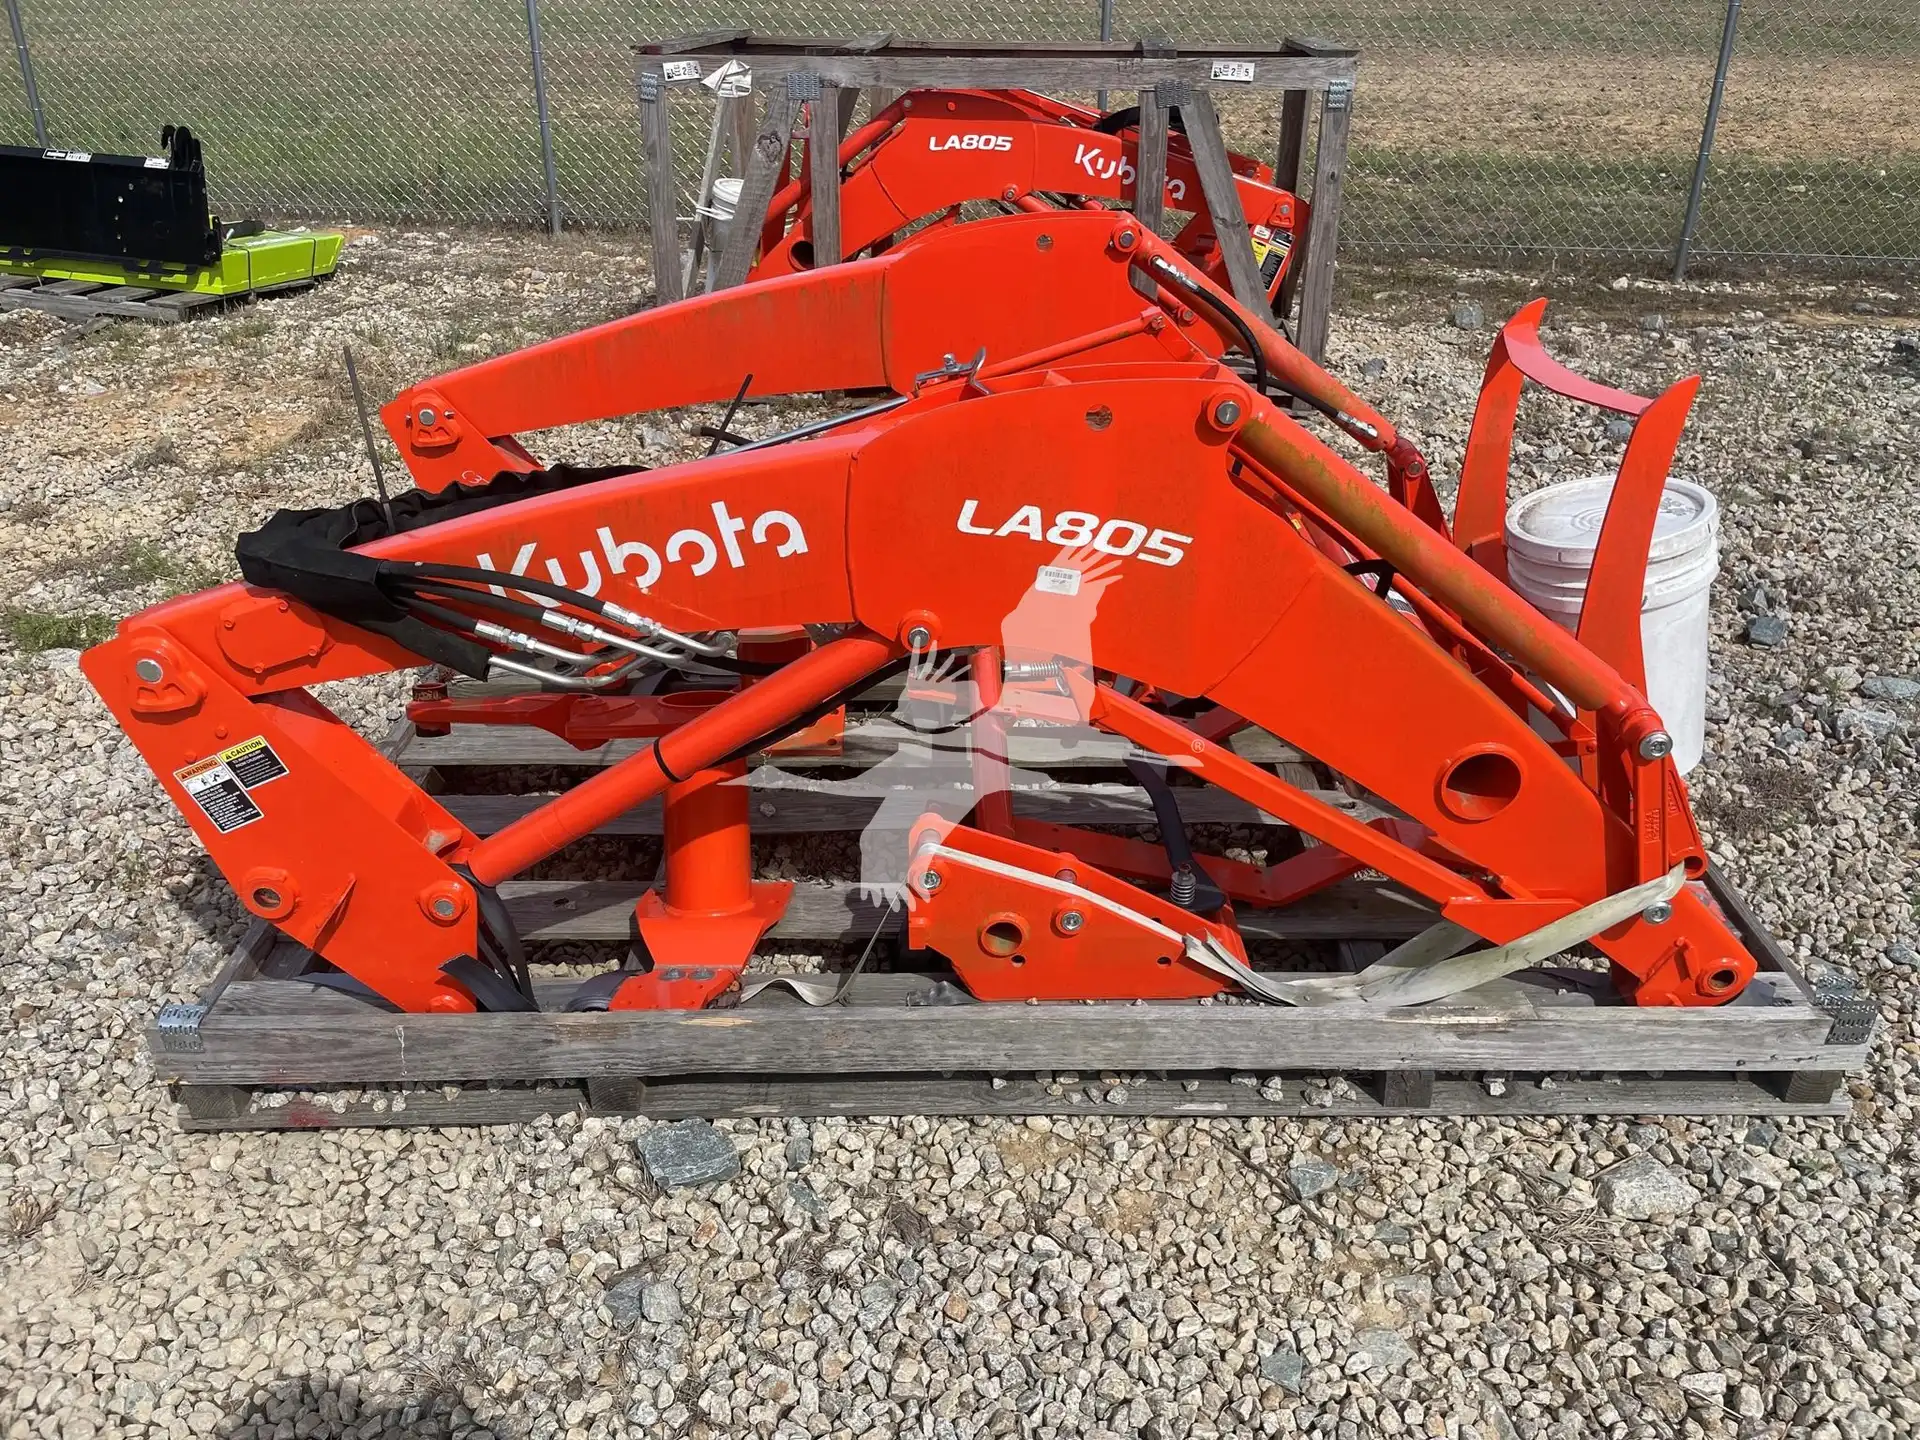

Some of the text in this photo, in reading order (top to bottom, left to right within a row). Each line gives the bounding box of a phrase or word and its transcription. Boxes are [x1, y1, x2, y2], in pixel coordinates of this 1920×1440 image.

[928, 134, 1014, 151] LA805
[1074, 143, 1186, 200] Kuba
[956, 499, 1194, 567] LA805
[231, 740, 262, 757] CAUTION
[185, 760, 217, 776] WARNING
